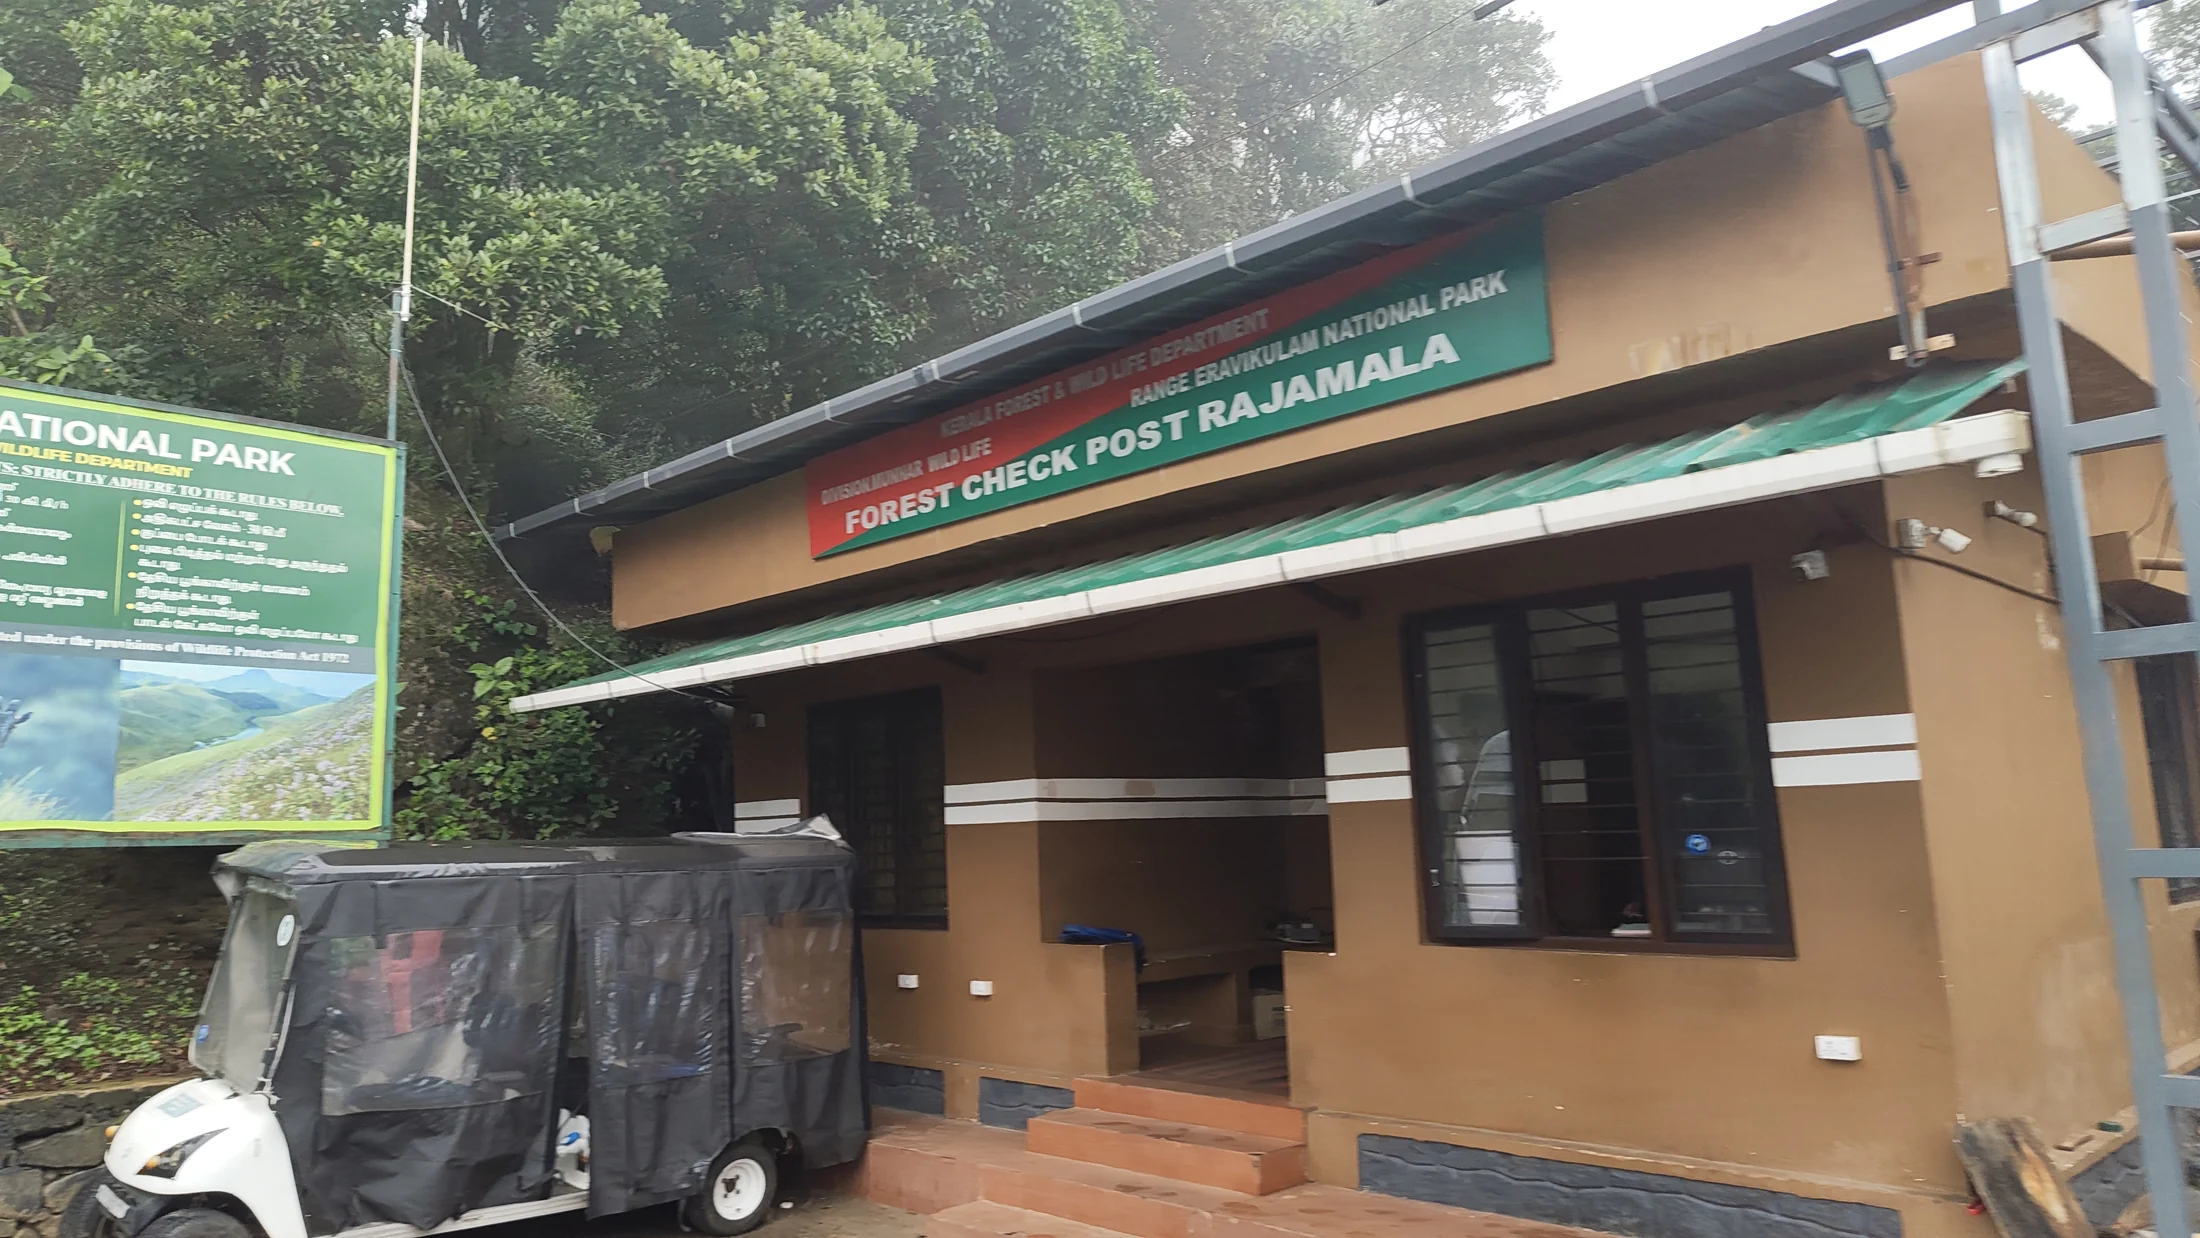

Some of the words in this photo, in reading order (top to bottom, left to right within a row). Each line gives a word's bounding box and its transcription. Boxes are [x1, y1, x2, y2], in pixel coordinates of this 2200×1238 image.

[995, 385, 1050, 420] FOREST
[1054, 381, 1067, 400] &
[1069, 366, 1107, 395] WILD
[1111, 352, 1147, 380] LIFE
[1151, 308, 1270, 367] DEPARTMENT
[1130, 372, 1191, 407] RANGE
[1194, 328, 1319, 387] ERAVIKULAM
[1323, 294, 1434, 346] NATIONAL
[1439, 269, 1509, 311] PARK
[0, 410, 182, 459] ATIONAL
[191, 438, 296, 476] PARK
[845, 482, 955, 534] FOREST
[961, 444, 1078, 500] CHECK
[1086, 410, 1190, 466] POST
[1199, 333, 1461, 433] RAJAMALA
[927, 448, 960, 472] WILD
[962, 437, 993, 462] LIFE
[21, 464, 108, 485] STRICTLY
[110, 476, 177, 494] ADHERE
[178, 485, 202, 497] TO
[203, 487, 236, 502] THE
[238, 492, 288, 508] RULES
[75, 452, 194, 478] DEPARTMENT
[24, 634, 70, 645] under
[69, 635, 94, 646] the
[94, 638, 164, 651] provisions
[165, 641, 181, 652] of
[180, 642, 233, 656] Wildlife
[234, 646, 297, 660] Protection
[297, 651, 320, 661] Act
[321, 652, 350, 663] 1972
